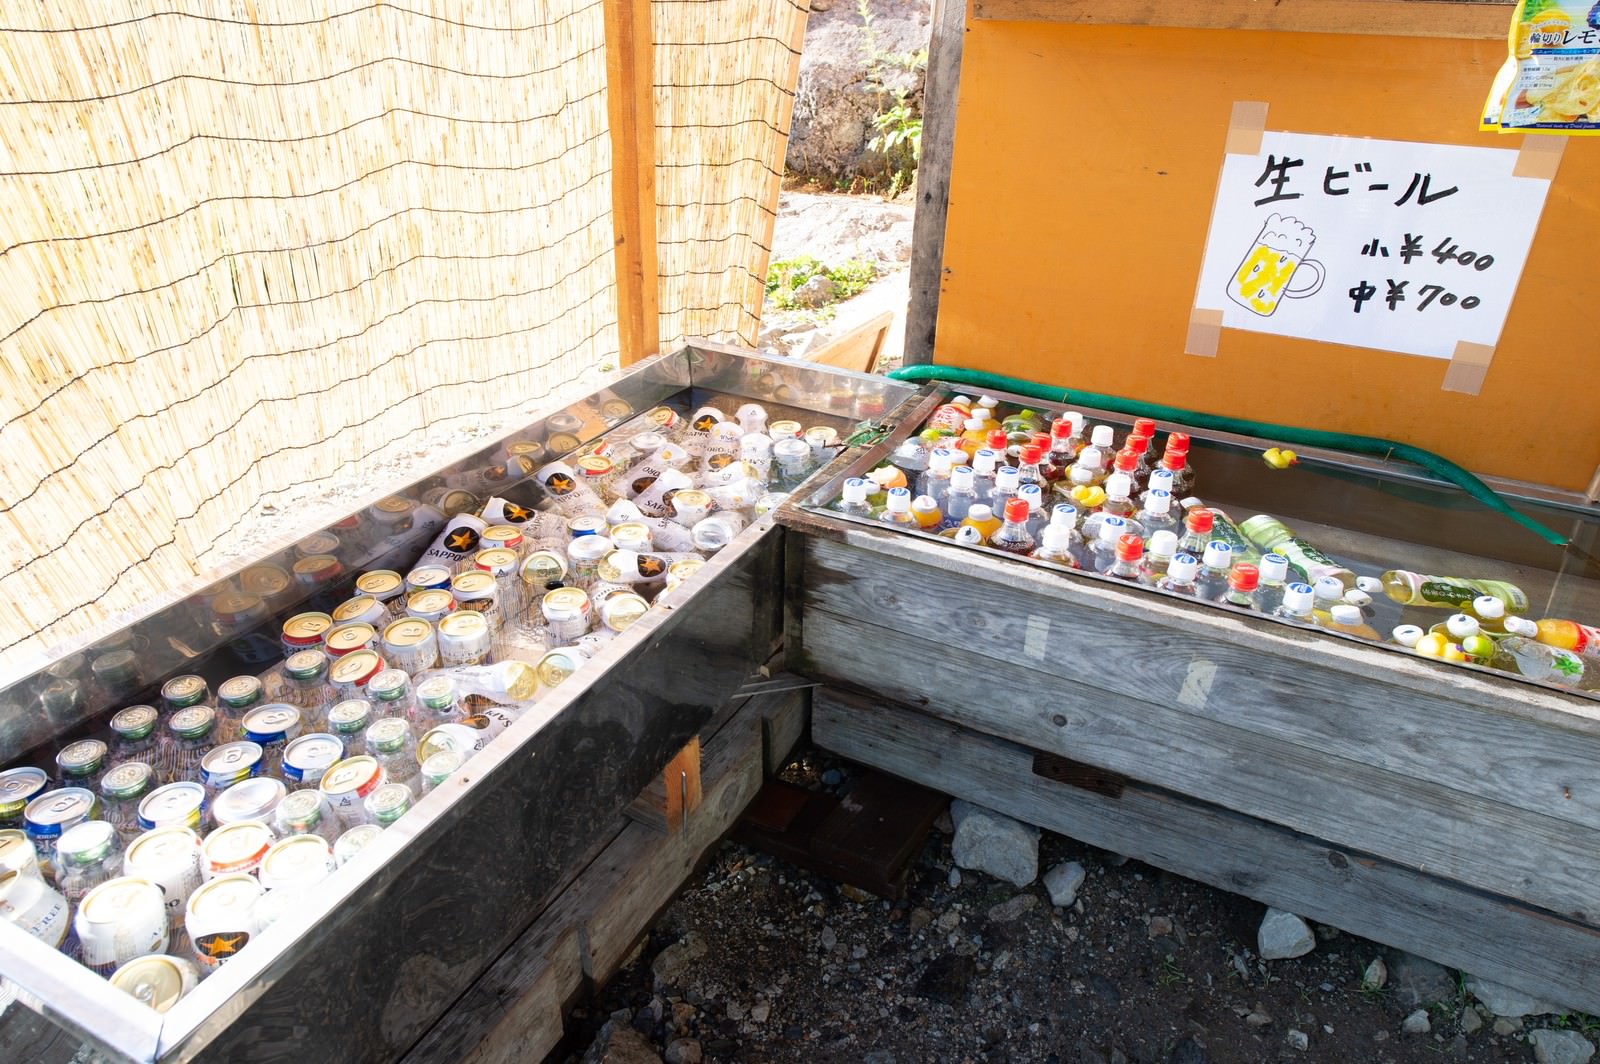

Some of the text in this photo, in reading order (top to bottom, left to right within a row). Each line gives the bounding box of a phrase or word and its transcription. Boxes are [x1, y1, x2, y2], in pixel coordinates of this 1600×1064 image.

[1530, 29, 1600, 45] 輪切りレモ
[1254, 153, 1459, 207] 生ビール
